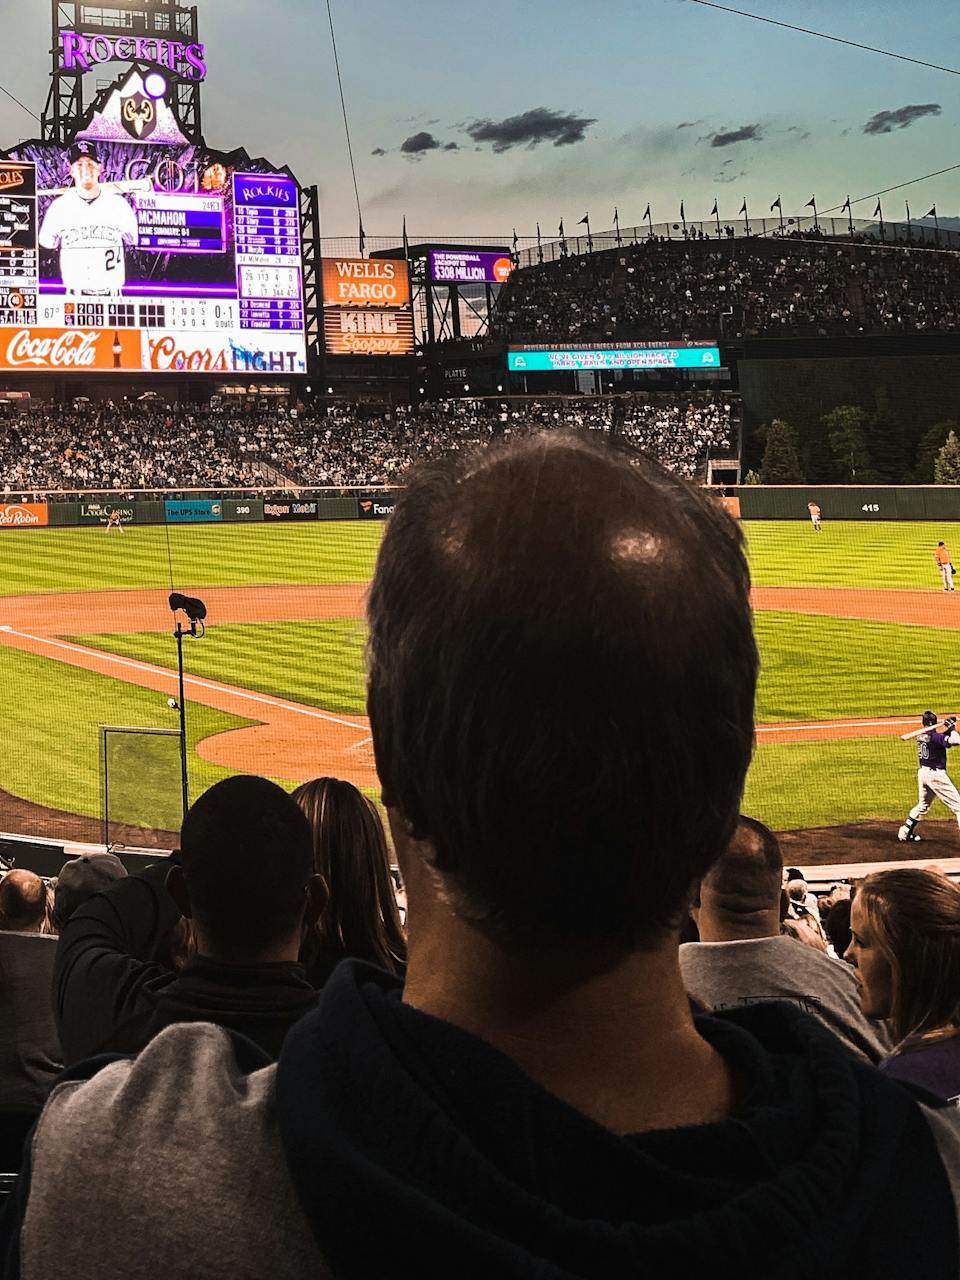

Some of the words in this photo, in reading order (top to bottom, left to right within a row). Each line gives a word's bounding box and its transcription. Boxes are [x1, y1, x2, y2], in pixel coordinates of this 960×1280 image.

[60, 30, 207, 81] ROCKIES
[243, 186, 290, 201] ROCKIES
[139, 211, 186, 226] MCMAHON
[335, 263, 394, 279] WELLS
[435, 266, 455, 279] $308
[455, 267, 485, 280] MILLION
[339, 283, 396, 299] FARGO
[24, 295, 35, 307] 32
[340, 313, 398, 333] KING
[6, 330, 101, 365] Coca-Cola
[149, 336, 228, 370] Coors
[862, 504, 879, 512] 415
[13, 512, 39, 525] Robin
